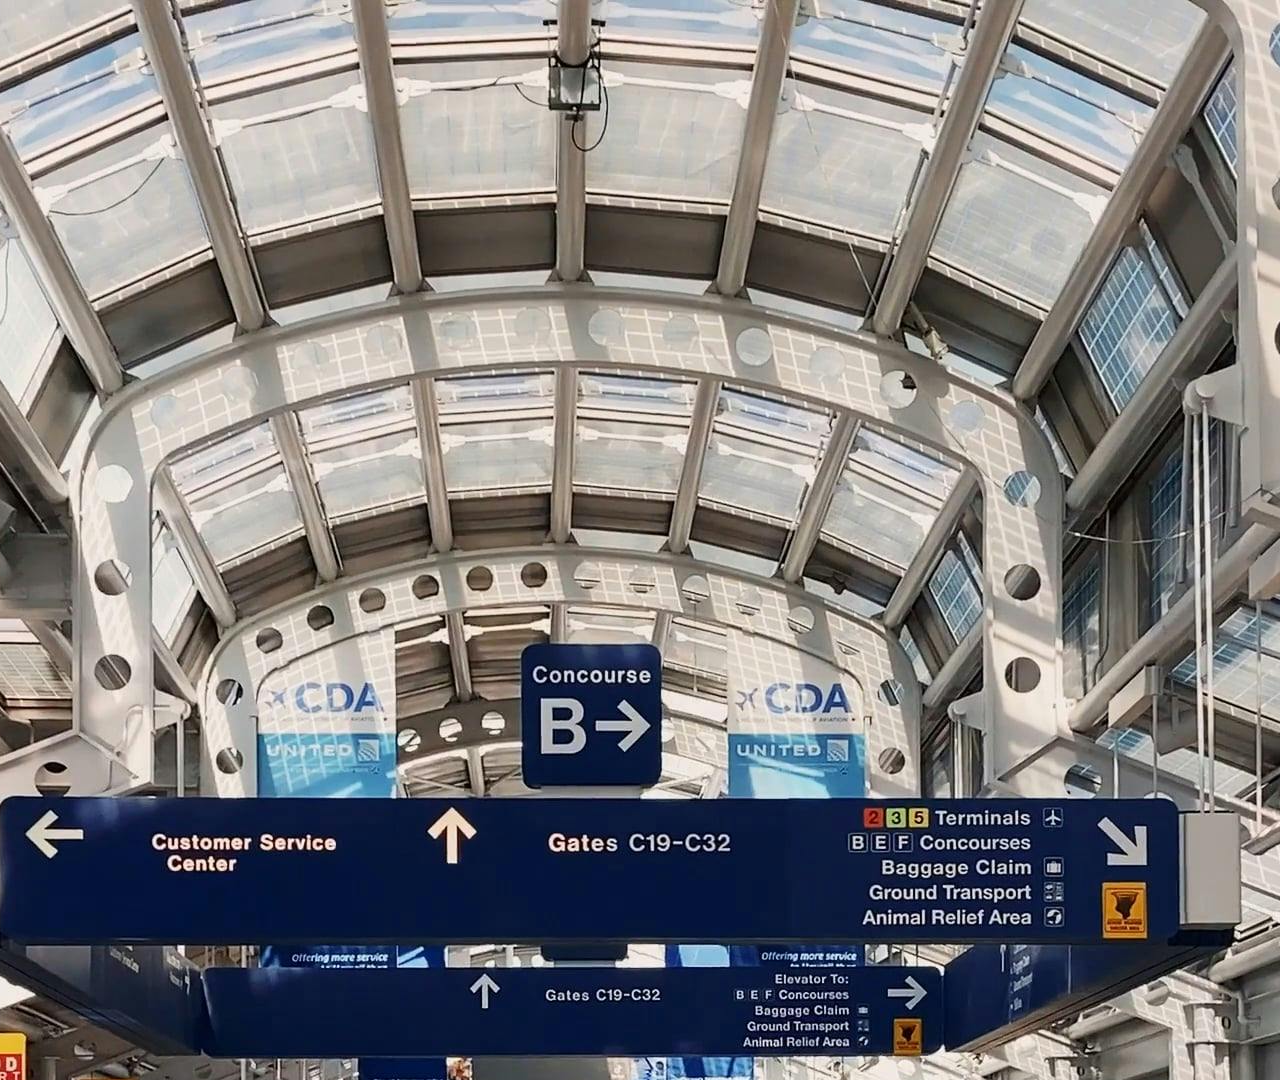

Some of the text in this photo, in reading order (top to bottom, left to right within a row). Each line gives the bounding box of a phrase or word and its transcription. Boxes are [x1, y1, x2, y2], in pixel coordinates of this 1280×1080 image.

[532, 665, 652, 684] Concourse
[294, 681, 384, 714] CDA
[764, 682, 852, 715] CDA
[540, 697, 587, 755] B
[266, 743, 353, 757] UNITED
[736, 744, 822, 757] UNITED
[868, 809, 1031, 826] 2 3 5 Terminals
[151, 833, 337, 851] Customer Service
[548, 833, 731, 852] Gates C19-C32
[851, 835, 1032, 851] B E F Concourses
[167, 854, 237, 872] Center
[881, 859, 1032, 878] Baggage Claim
[869, 884, 1032, 903] Ground Transport
[862, 909, 1032, 926] Animal Relief Area
[291, 952, 389, 963] Offering more service
[761, 951, 858, 962] Offering more service
[774, 974, 849, 985] Elevator To:
[545, 989, 661, 1001] Gates C19-C32
[736, 989, 850, 1000] B E F Concourses
[755, 1005, 850, 1018] Baggage Claim
[747, 1021, 850, 1034] Ground Transport
[743, 1037, 850, 1048] Animal Relief Area
